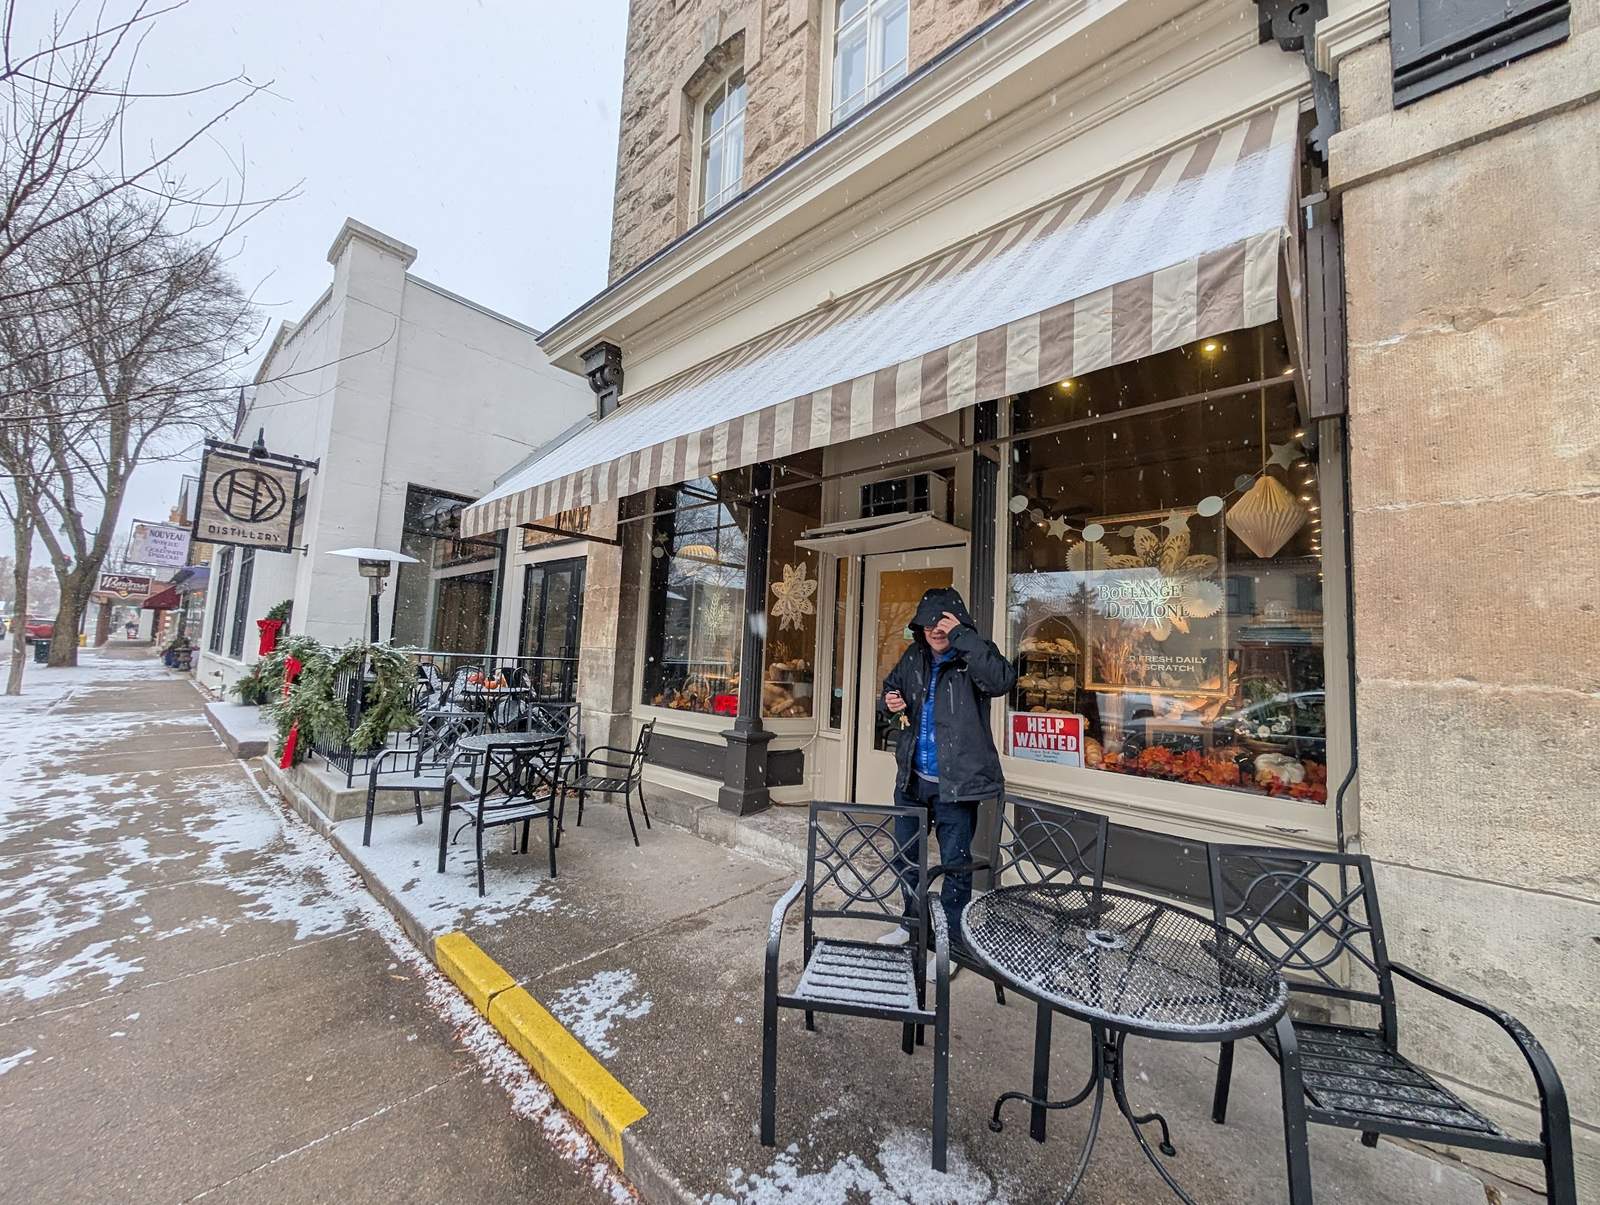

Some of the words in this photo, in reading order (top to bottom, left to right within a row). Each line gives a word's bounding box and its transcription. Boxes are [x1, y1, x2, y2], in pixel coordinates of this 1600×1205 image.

[149, 529, 186, 542] NOUVEAU
[208, 524, 280, 542] DISTILLERY
[1138, 655, 1174, 664] FRESH
[1175, 656, 1208, 665] DAILY
[1144, 664, 1195, 673] SCRATCH
[1027, 717, 1065, 734] HELP
[1015, 731, 1077, 751] WANTED
